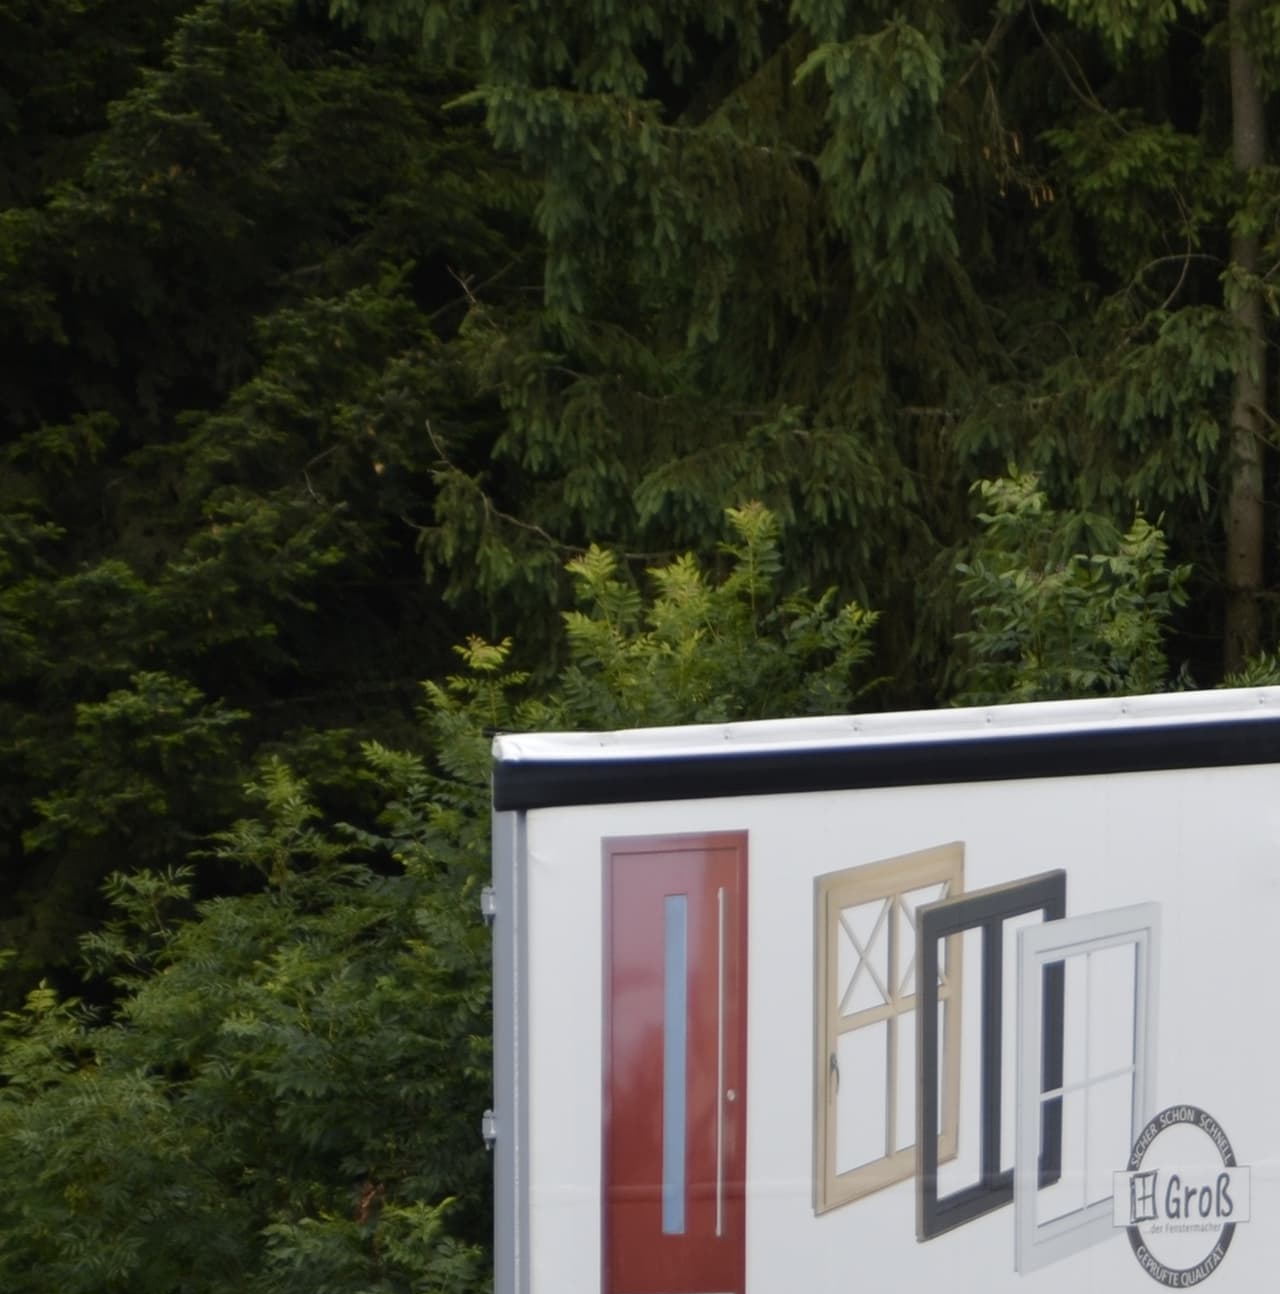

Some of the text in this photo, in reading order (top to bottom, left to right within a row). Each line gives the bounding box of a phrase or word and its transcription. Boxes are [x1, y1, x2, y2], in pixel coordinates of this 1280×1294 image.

[1131, 1106, 1233, 1169] SICHER SCHÖN SCHNELL
[1165, 1172, 1234, 1220] Groß
